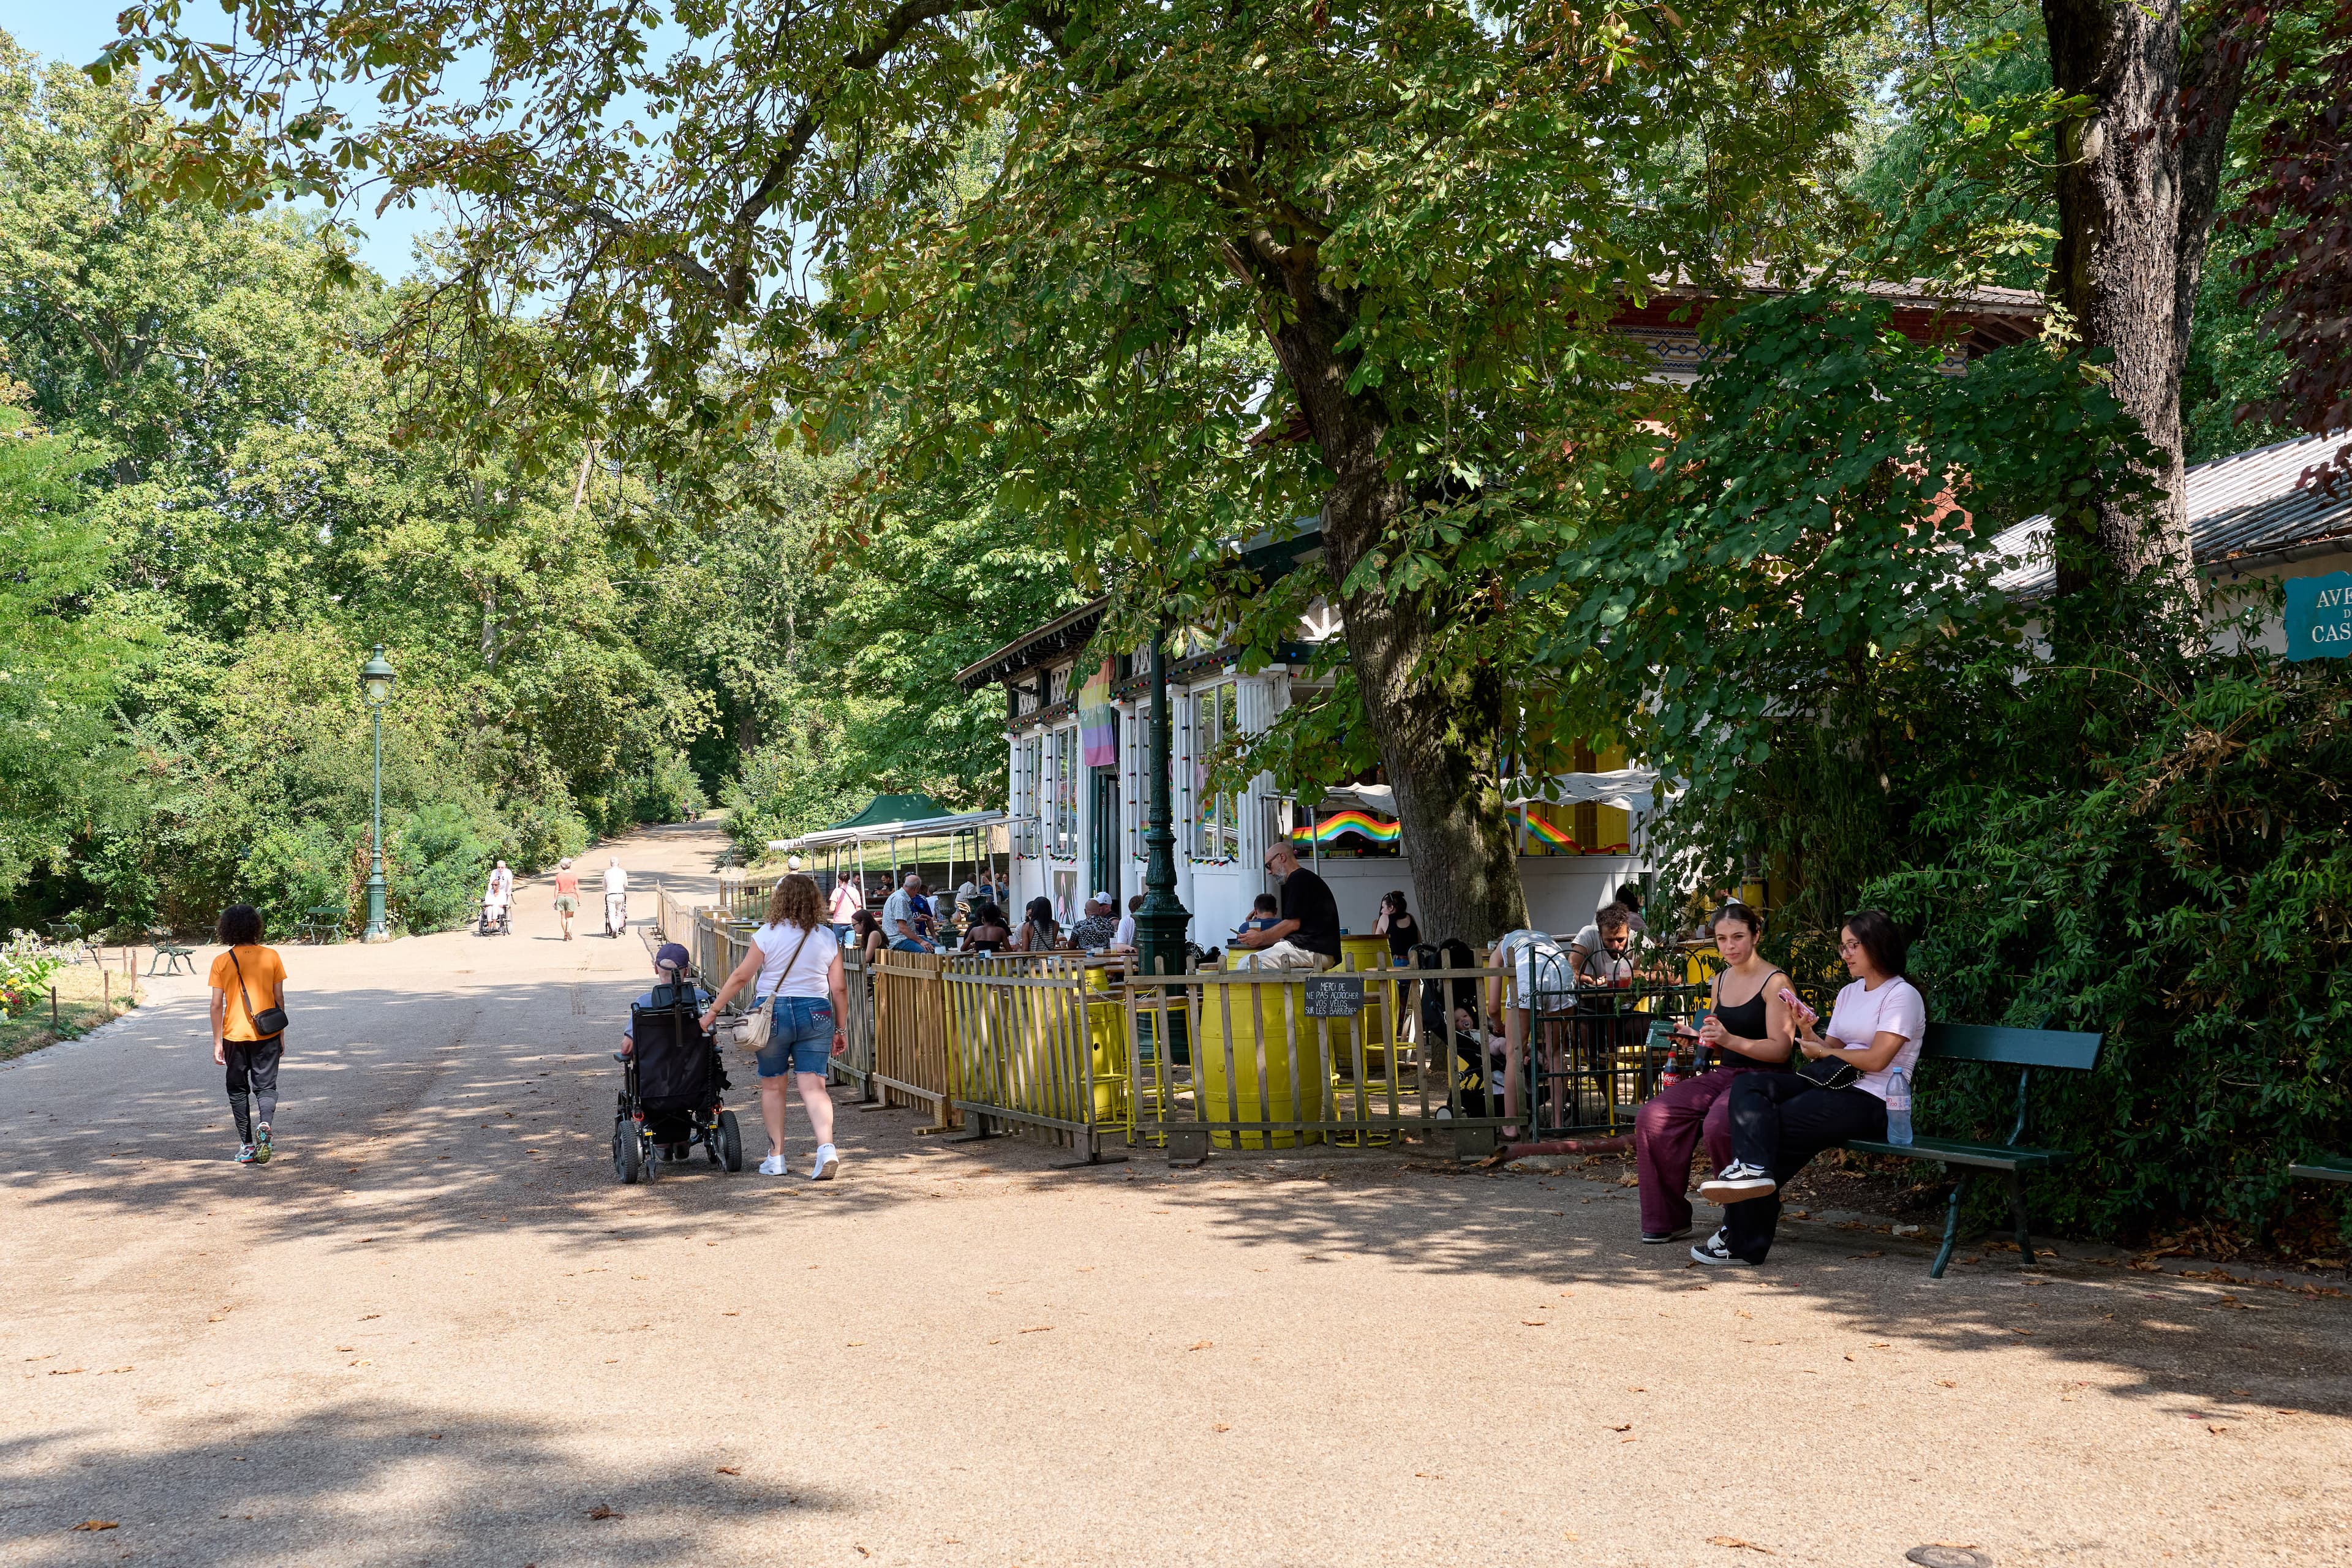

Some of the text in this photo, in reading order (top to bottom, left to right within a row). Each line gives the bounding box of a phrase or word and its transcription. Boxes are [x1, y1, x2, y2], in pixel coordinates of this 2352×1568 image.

[2316, 587, 2352, 608] AVE
[2343, 609, 2352, 618] D
[2312, 622, 2351, 643] CAS
